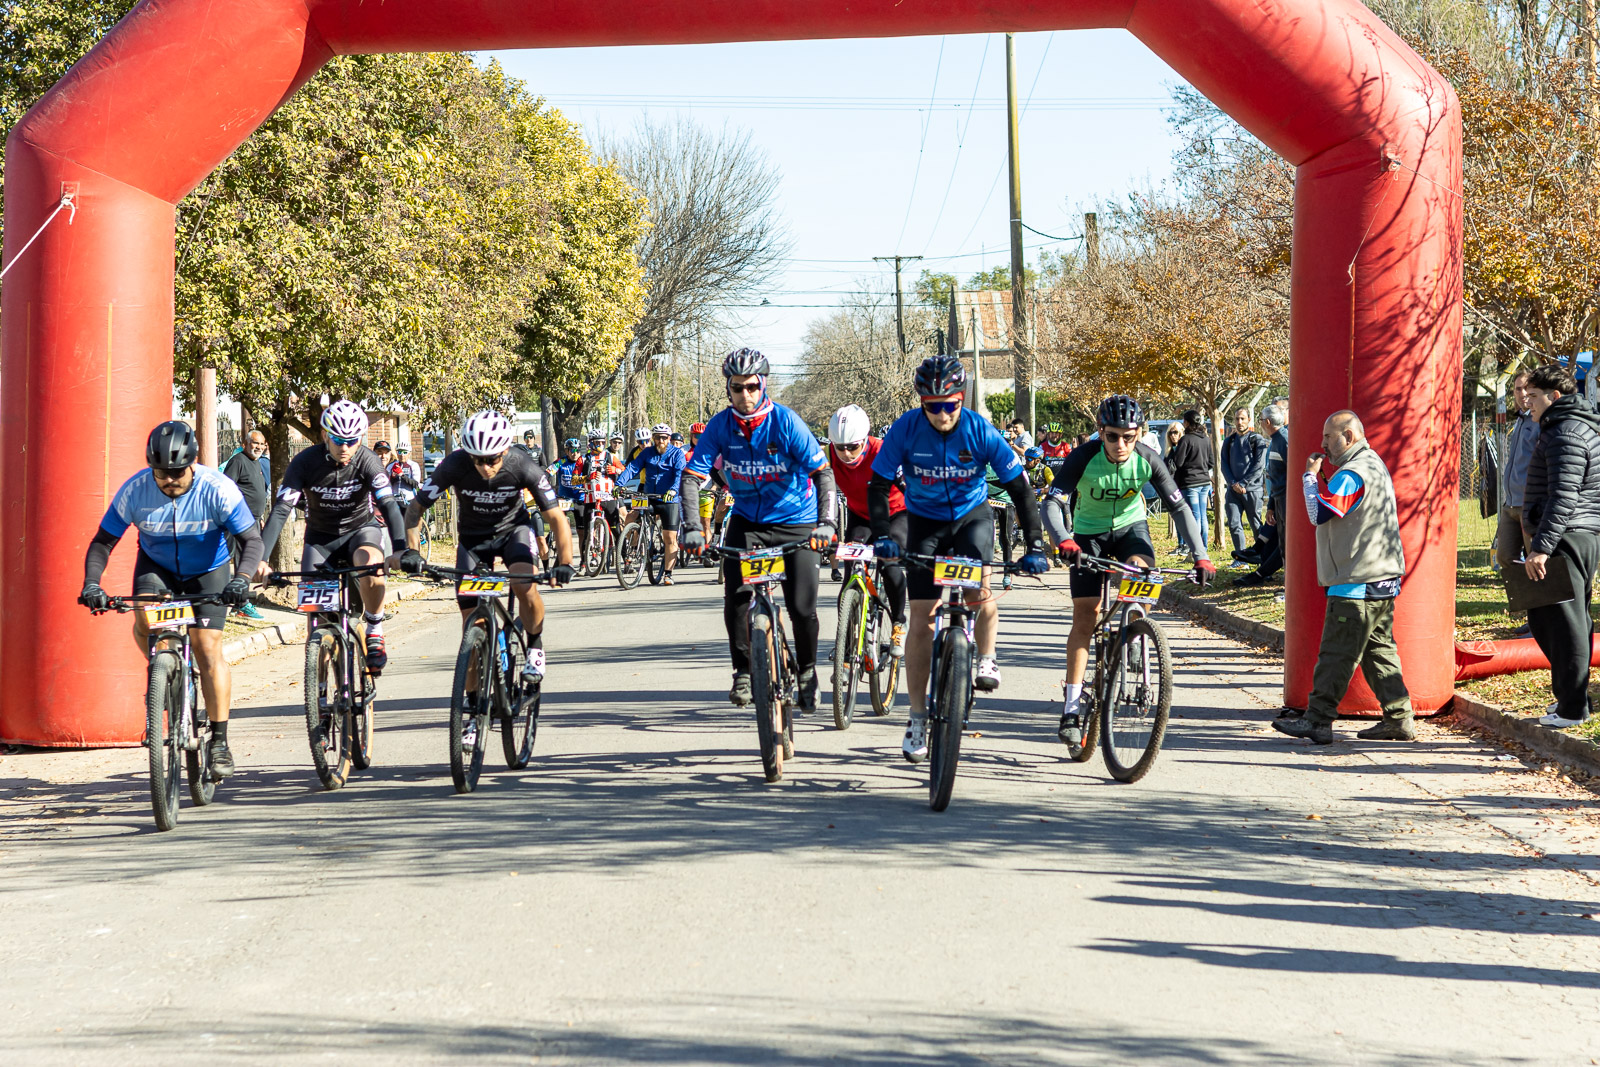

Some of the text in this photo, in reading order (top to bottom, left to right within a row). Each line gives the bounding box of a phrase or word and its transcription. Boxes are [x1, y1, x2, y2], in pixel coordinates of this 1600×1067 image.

[724, 460, 788, 475] PELOTON
[913, 465, 978, 478] PELOTON
[731, 471, 785, 485] BRUTAL
[310, 484, 363, 494] NACHOS
[461, 489, 519, 498] NACHOS
[1090, 488, 1138, 501] USA
[139, 519, 214, 533] GIANT
[750, 558, 776, 575] 97
[944, 565, 974, 579] 98
[469, 581, 499, 591] 113
[1126, 581, 1156, 597] 119
[301, 589, 335, 604] 215
[155, 607, 185, 621] 101
